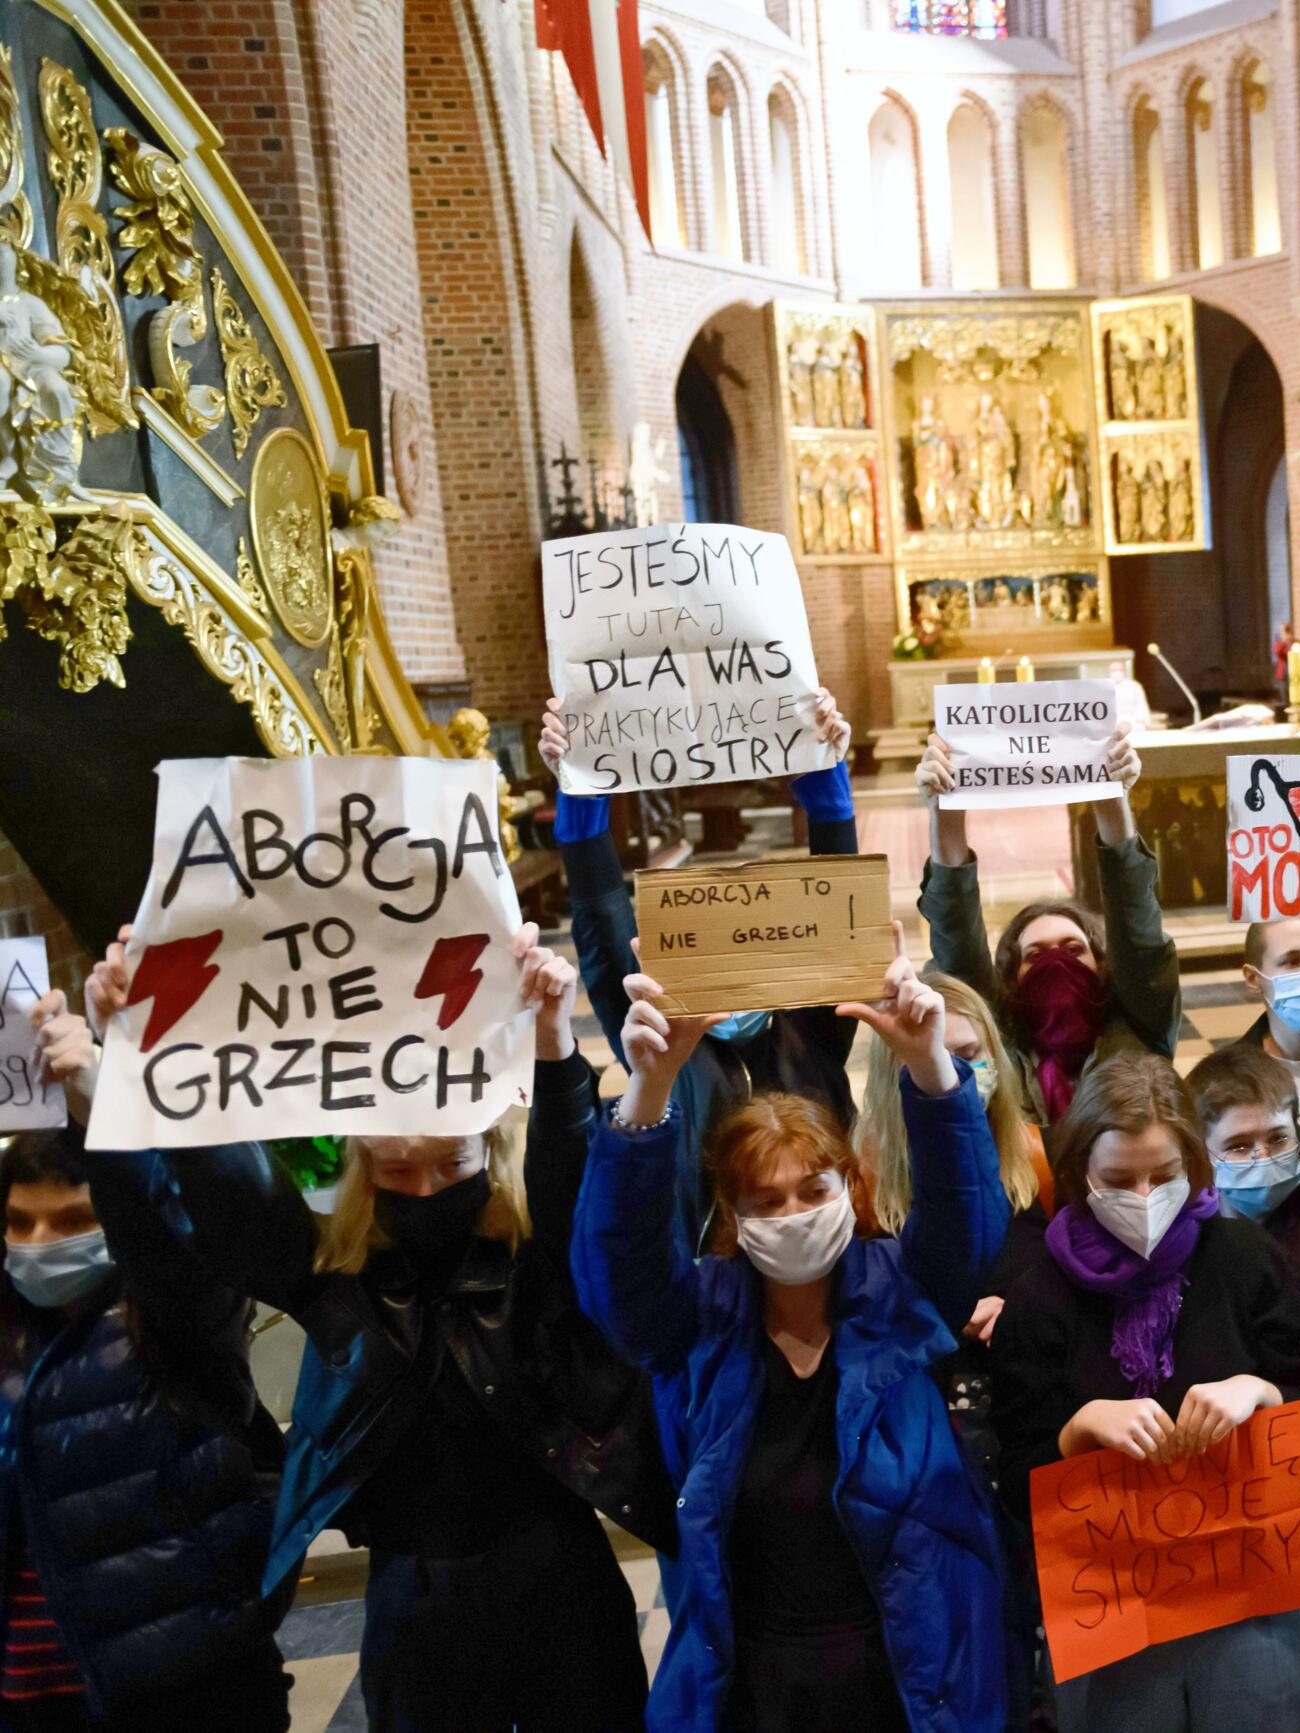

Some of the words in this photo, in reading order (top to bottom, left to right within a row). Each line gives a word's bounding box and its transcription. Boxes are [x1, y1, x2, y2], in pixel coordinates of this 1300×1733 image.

[554, 525, 764, 619] JESTEŚMY
[597, 603, 725, 642] TUTAJ
[584, 644, 687, 694] DLA
[705, 637, 792, 685] WAS
[564, 694, 797, 750] PRAKTYKUJĄCE
[945, 701, 1109, 726] KATOLICZKO
[589, 728, 803, 790] SIOSTRY
[1009, 735, 1051, 755] NIE
[950, 760, 1035, 791] ESTEŚ
[1041, 764, 1112, 785] SAMA
[162, 792, 503, 923] ABORCJA
[1230, 823, 1292, 859] OTO
[660, 883, 771, 909] ABORCJA
[800, 877, 831, 897] TO
[263, 916, 356, 971] TO
[660, 931, 697, 952] NIE
[732, 923, 818, 945] GRZECH
[237, 965, 383, 1032] NIE
[143, 1033, 491, 1121] GRZECH
[1086, 1476, 1271, 1552] MOJE
